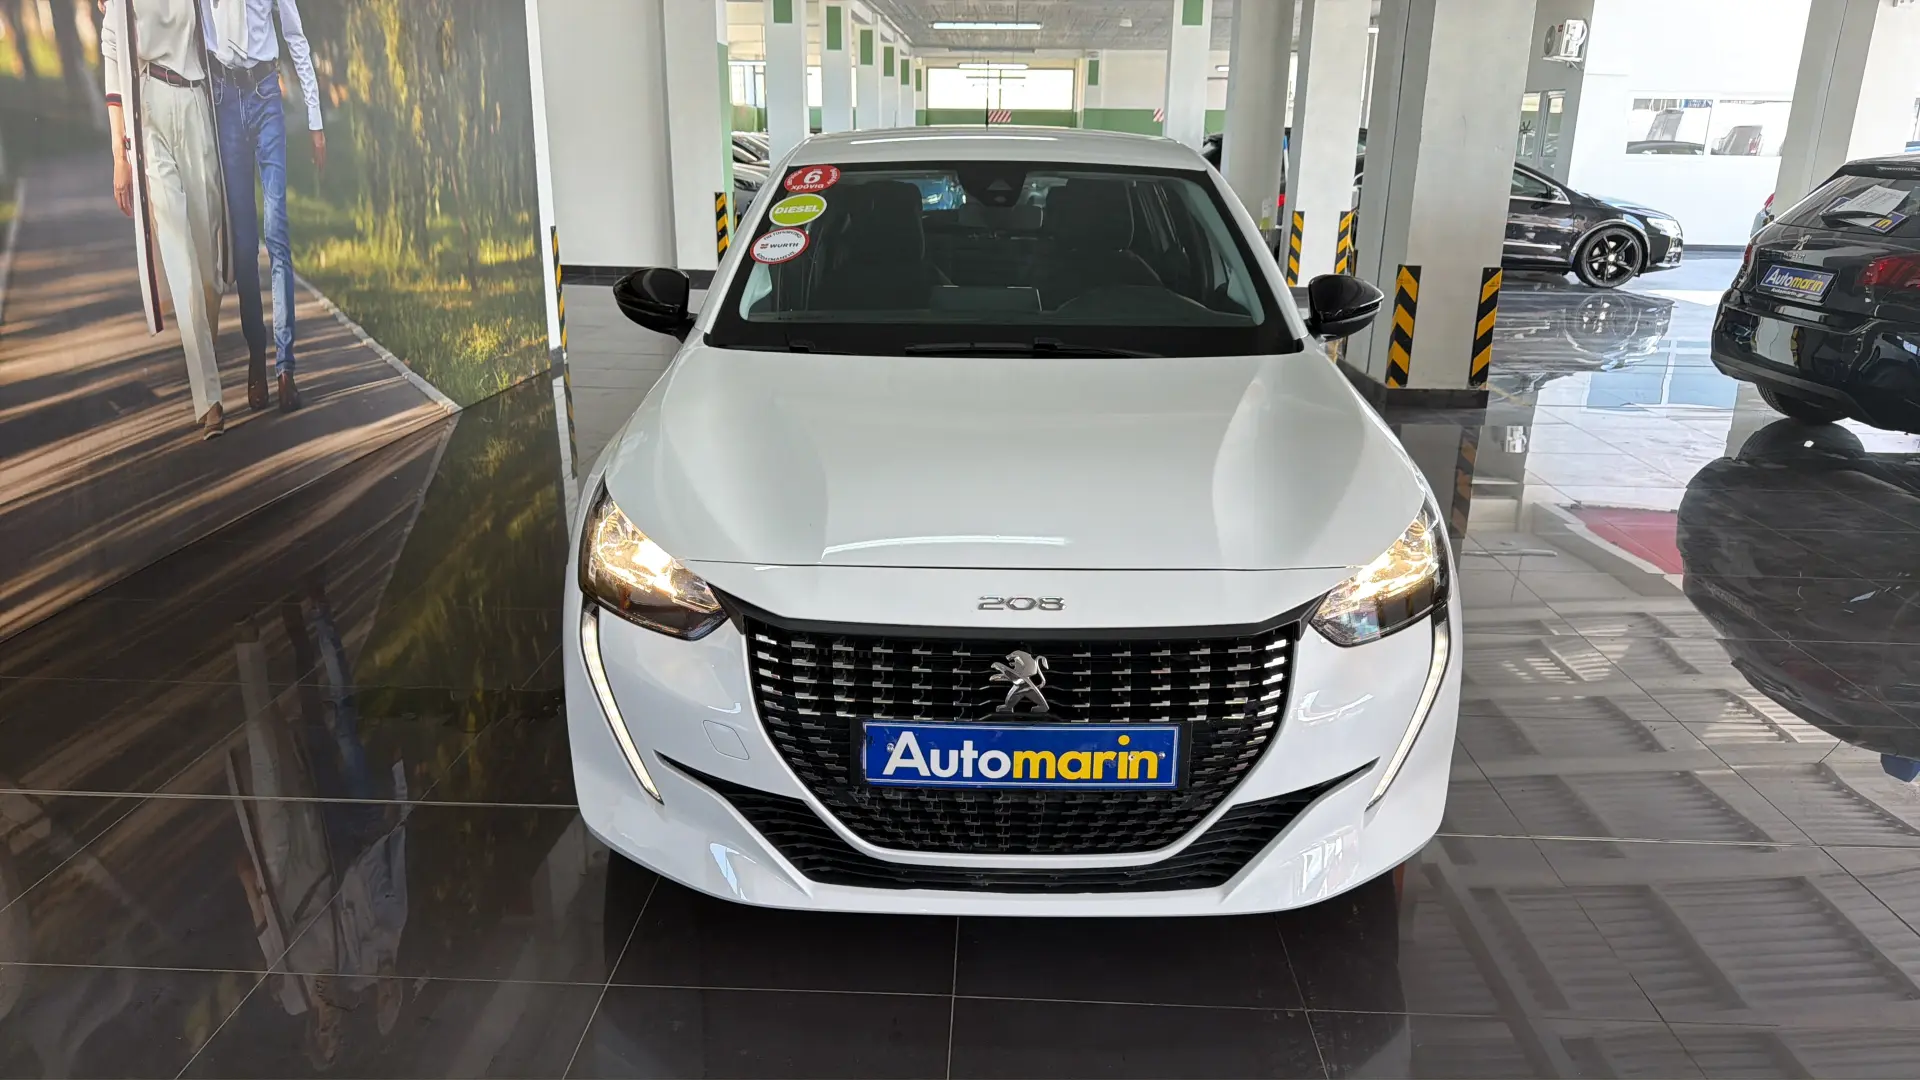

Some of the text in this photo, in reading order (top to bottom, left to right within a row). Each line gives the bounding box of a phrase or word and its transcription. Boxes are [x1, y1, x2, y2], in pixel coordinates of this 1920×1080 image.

[804, 170, 823, 184] 6
[775, 205, 820, 214] DIESEL
[1765, 268, 1824, 292] Automarin
[977, 596, 1066, 611] 208
[882, 731, 1158, 780] Automarin
